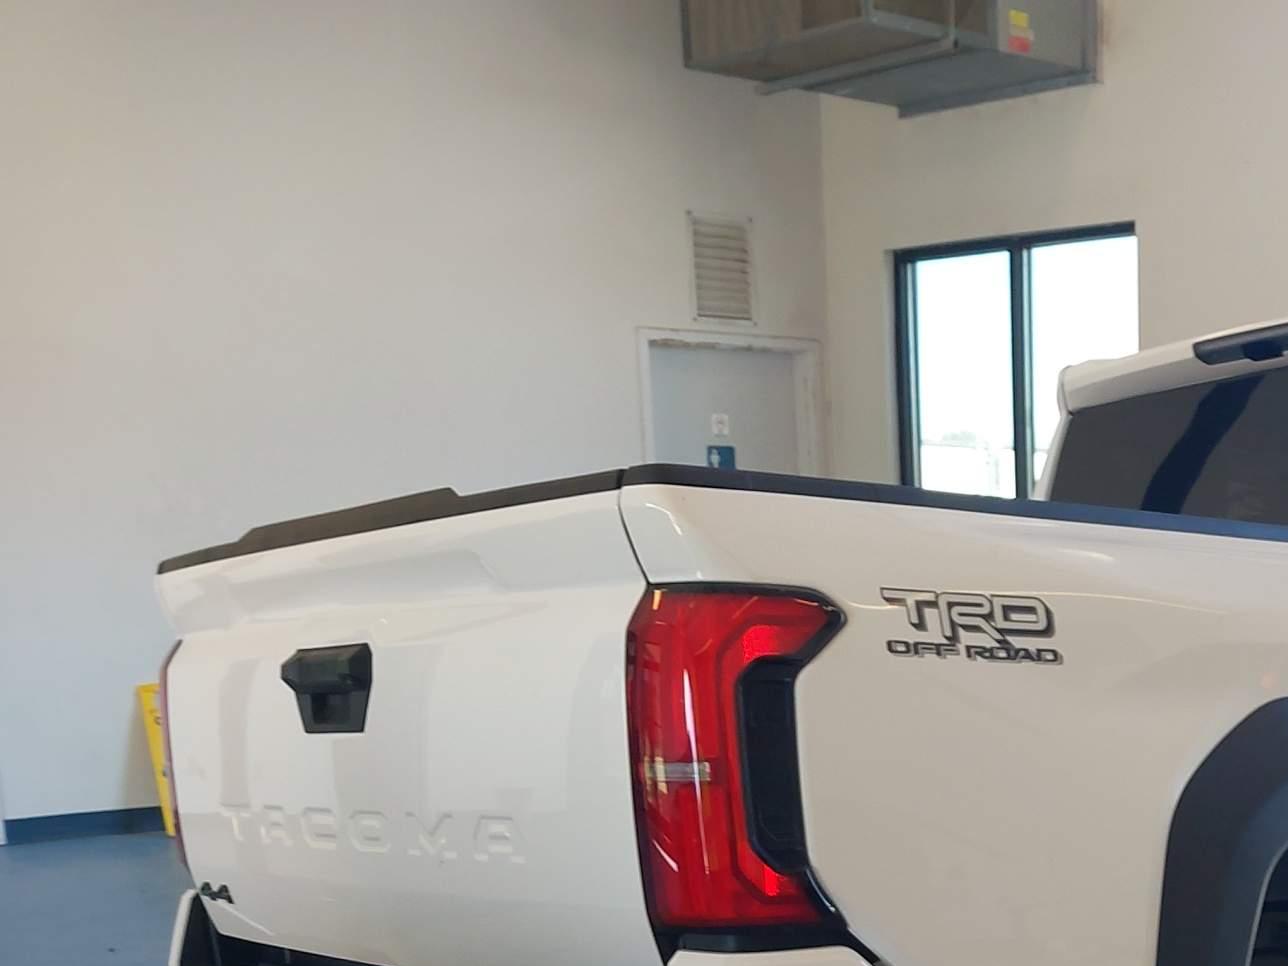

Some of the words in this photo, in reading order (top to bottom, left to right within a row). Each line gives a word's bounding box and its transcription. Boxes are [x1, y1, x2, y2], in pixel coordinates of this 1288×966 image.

[880, 587, 1056, 645] TRD
[886, 640, 960, 660] OFF
[965, 645, 1063, 665] ROAD
[219, 803, 528, 865] TACOMA
